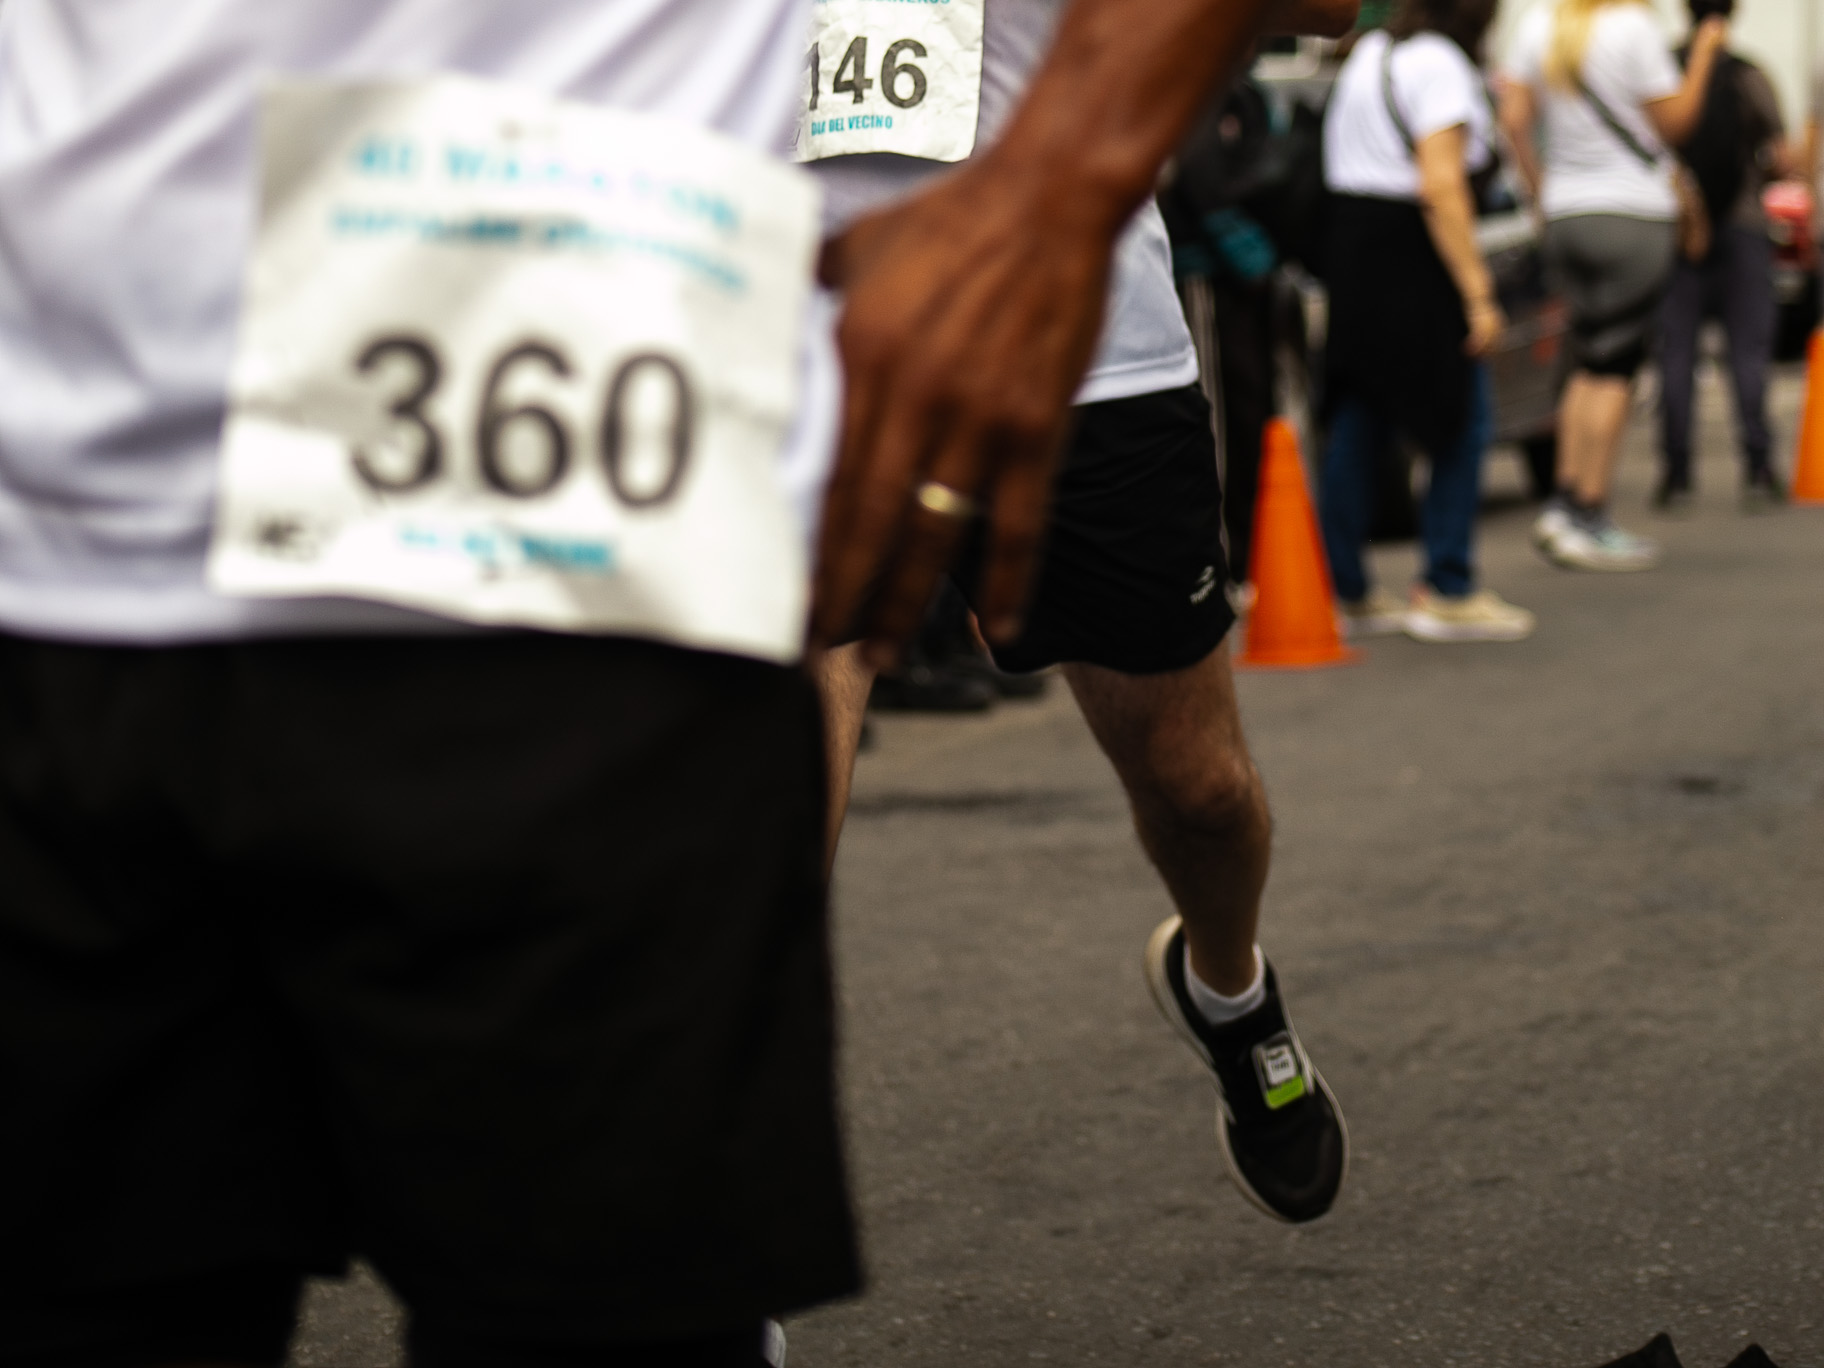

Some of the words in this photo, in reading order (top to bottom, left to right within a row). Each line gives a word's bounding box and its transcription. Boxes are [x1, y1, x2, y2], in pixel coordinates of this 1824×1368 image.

[801, 35, 928, 110] 146
[828, 118, 844, 132] DEL
[848, 114, 893, 130] VECINO
[349, 327, 700, 512] 360
